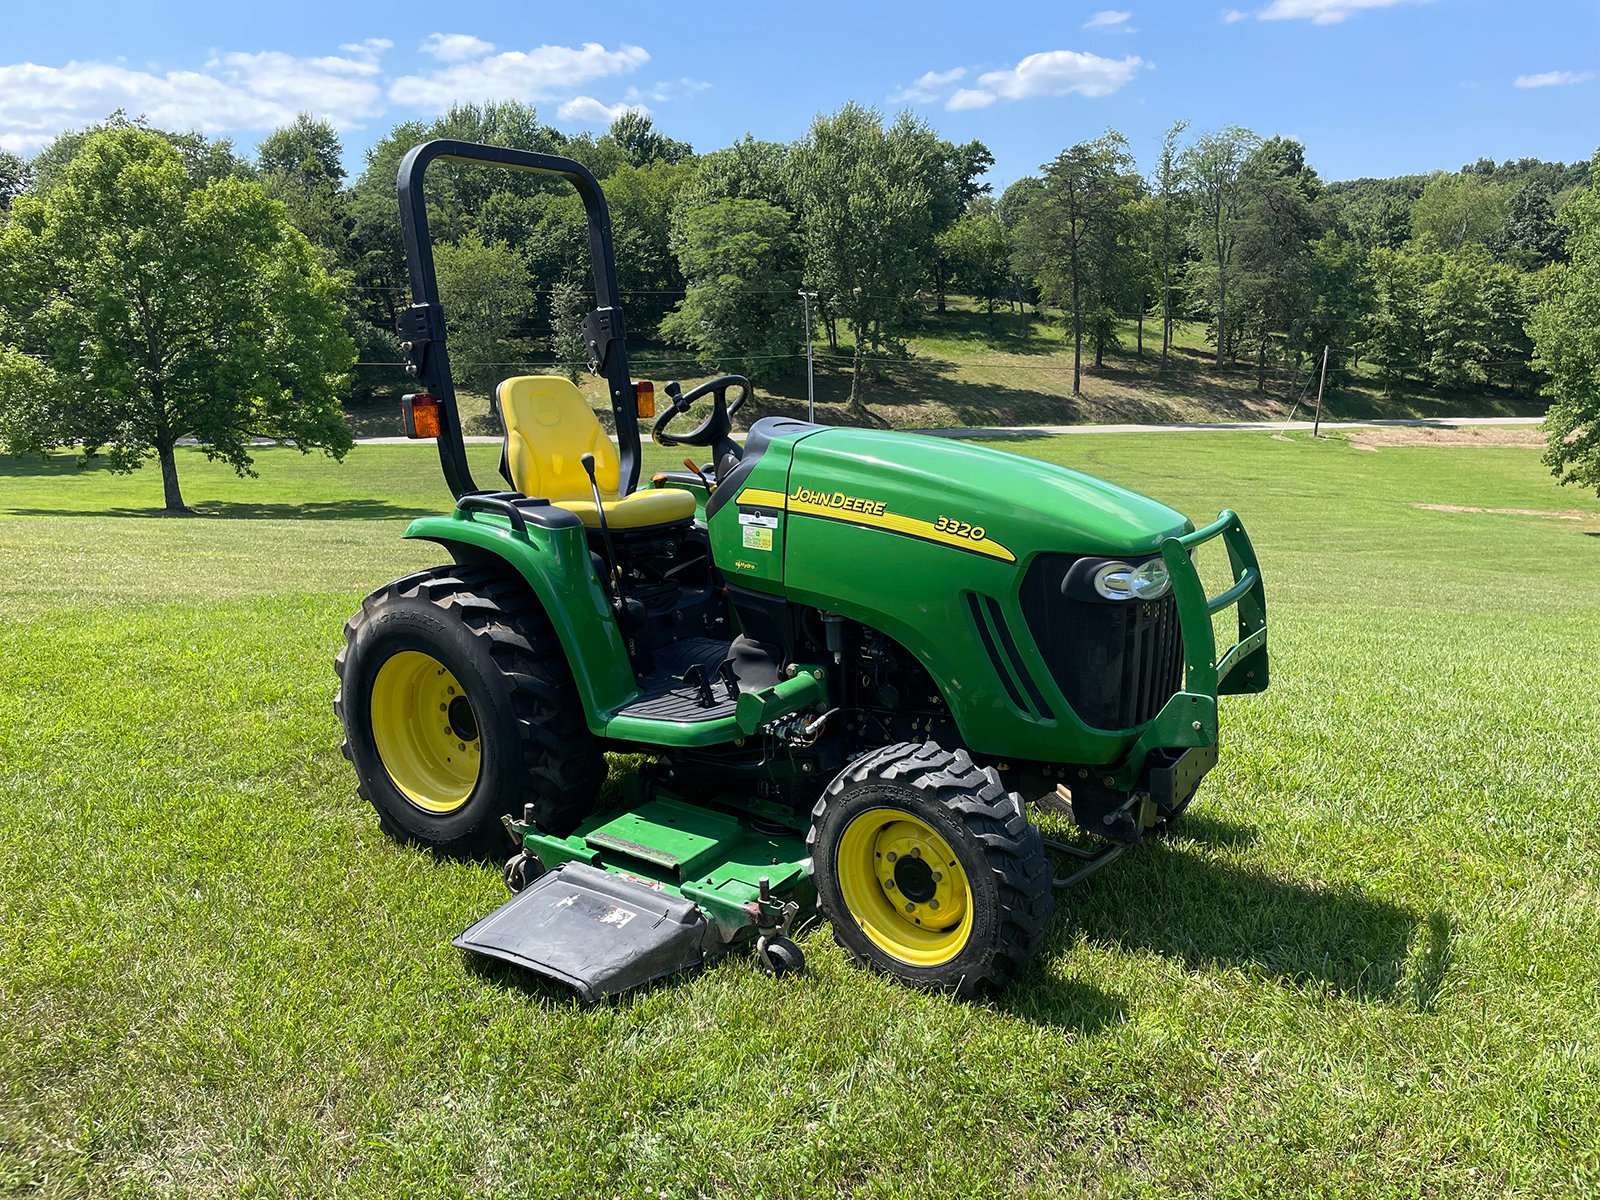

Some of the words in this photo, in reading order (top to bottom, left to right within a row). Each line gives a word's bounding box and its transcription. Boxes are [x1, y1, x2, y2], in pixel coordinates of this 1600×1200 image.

[788, 486, 832, 507] JOHN
[830, 491, 887, 517] DEERE
[934, 516, 986, 541] 3320
[379, 610, 447, 632] GALAXY
